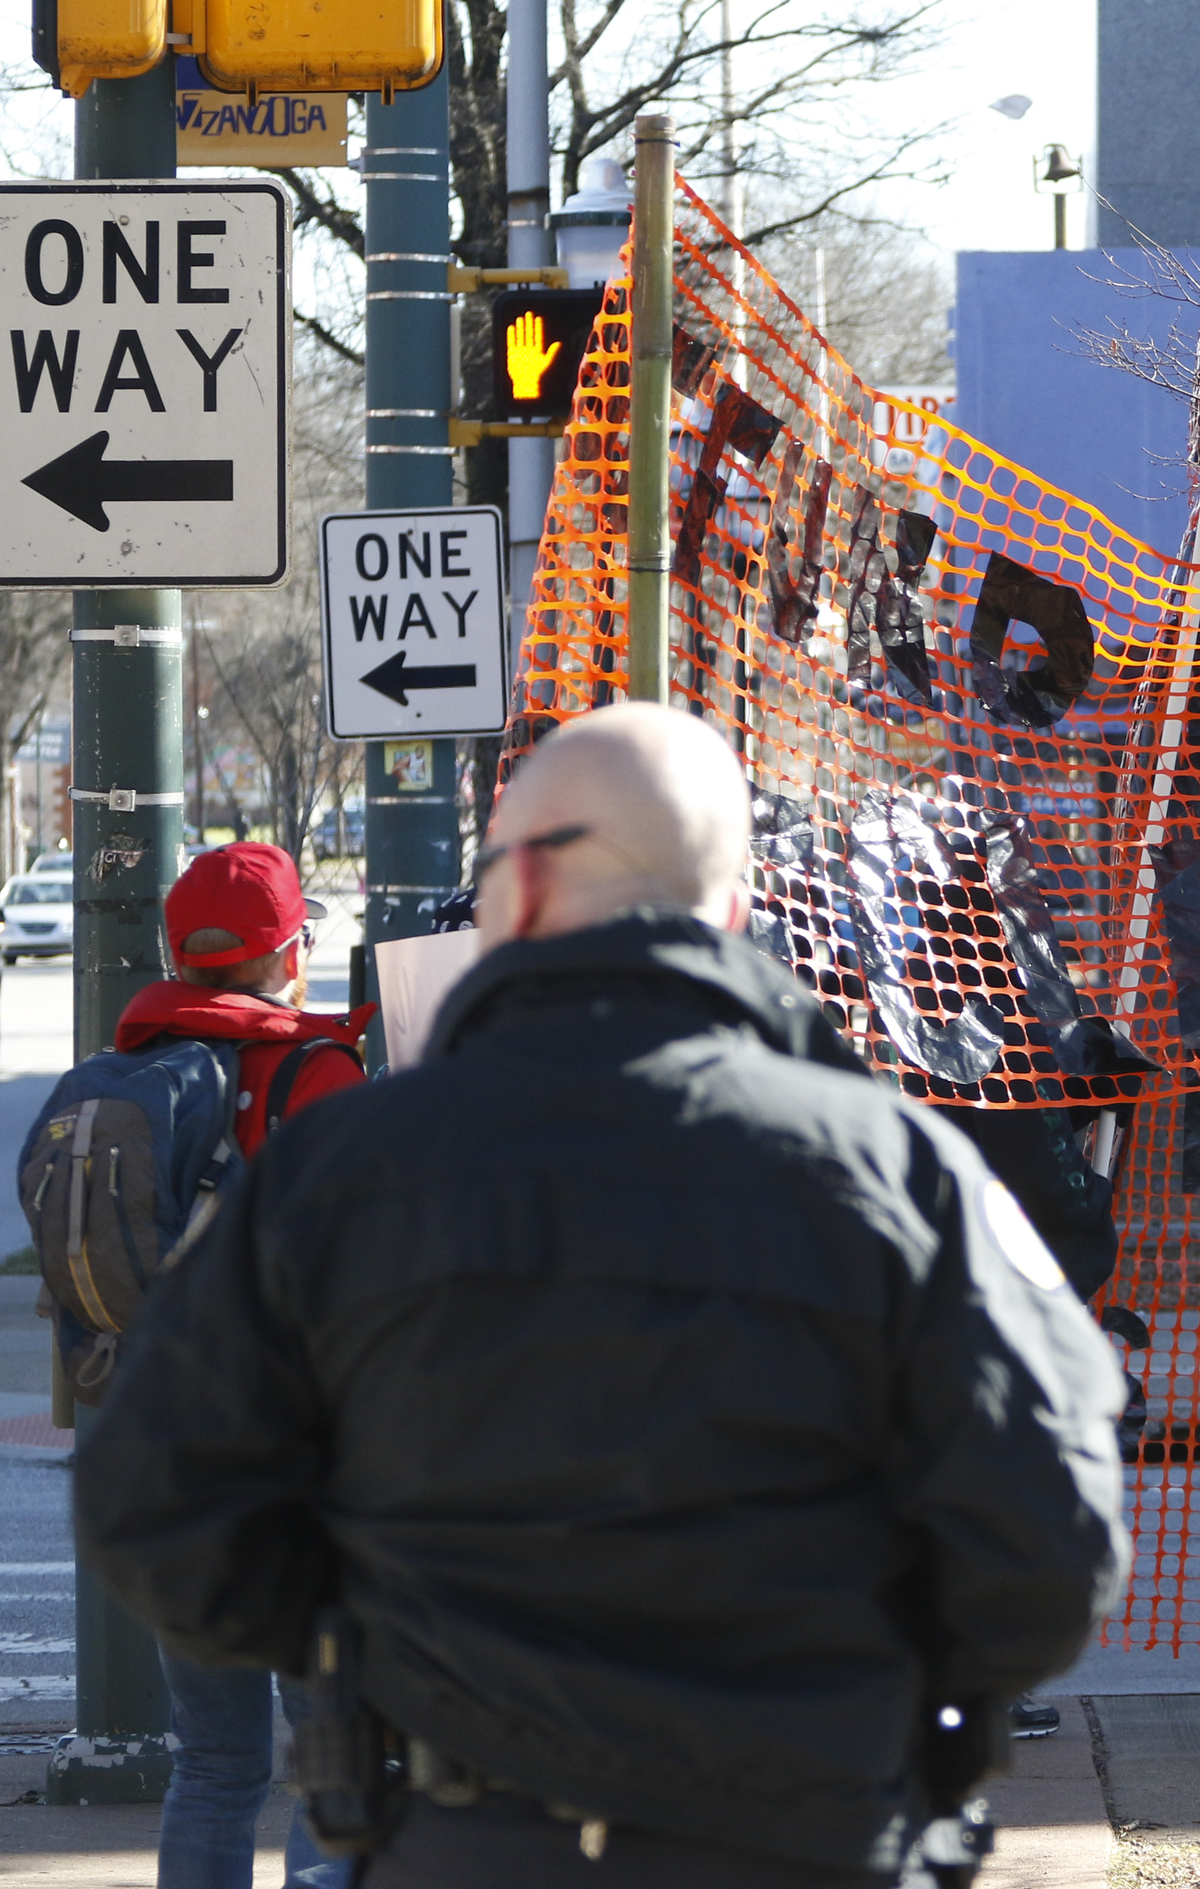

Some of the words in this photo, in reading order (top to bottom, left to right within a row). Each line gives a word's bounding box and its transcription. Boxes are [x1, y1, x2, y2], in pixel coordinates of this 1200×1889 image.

[24, 218, 230, 306] ONE
[10, 328, 243, 413] WAY
[355, 529, 471, 582] ONE
[349, 589, 479, 642] WAY
